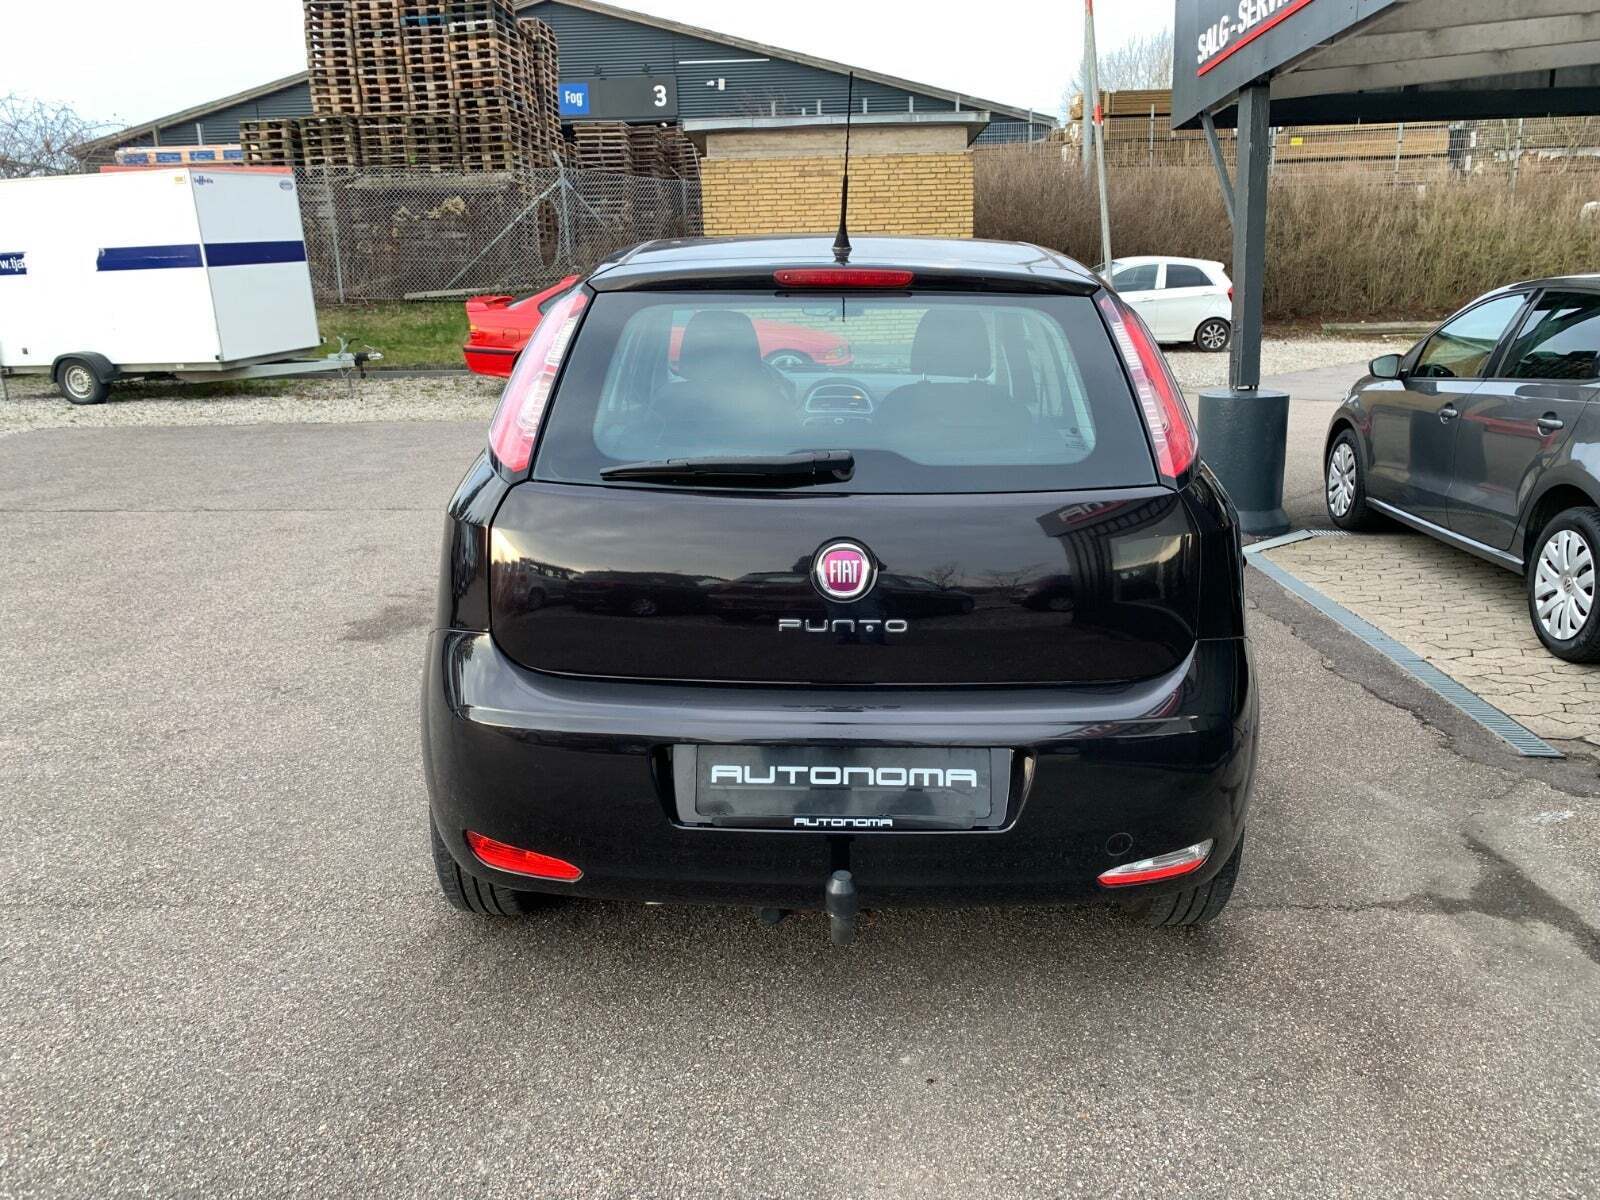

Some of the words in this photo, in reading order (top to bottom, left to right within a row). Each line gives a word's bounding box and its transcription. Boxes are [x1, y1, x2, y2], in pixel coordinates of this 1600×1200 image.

[653, 85, 667, 107] 3
[830, 560, 859, 583] FIAT
[778, 619, 907, 632] PUNTO
[711, 765, 977, 787] AUTONOMA
[794, 818, 893, 827] AUTONOMA
